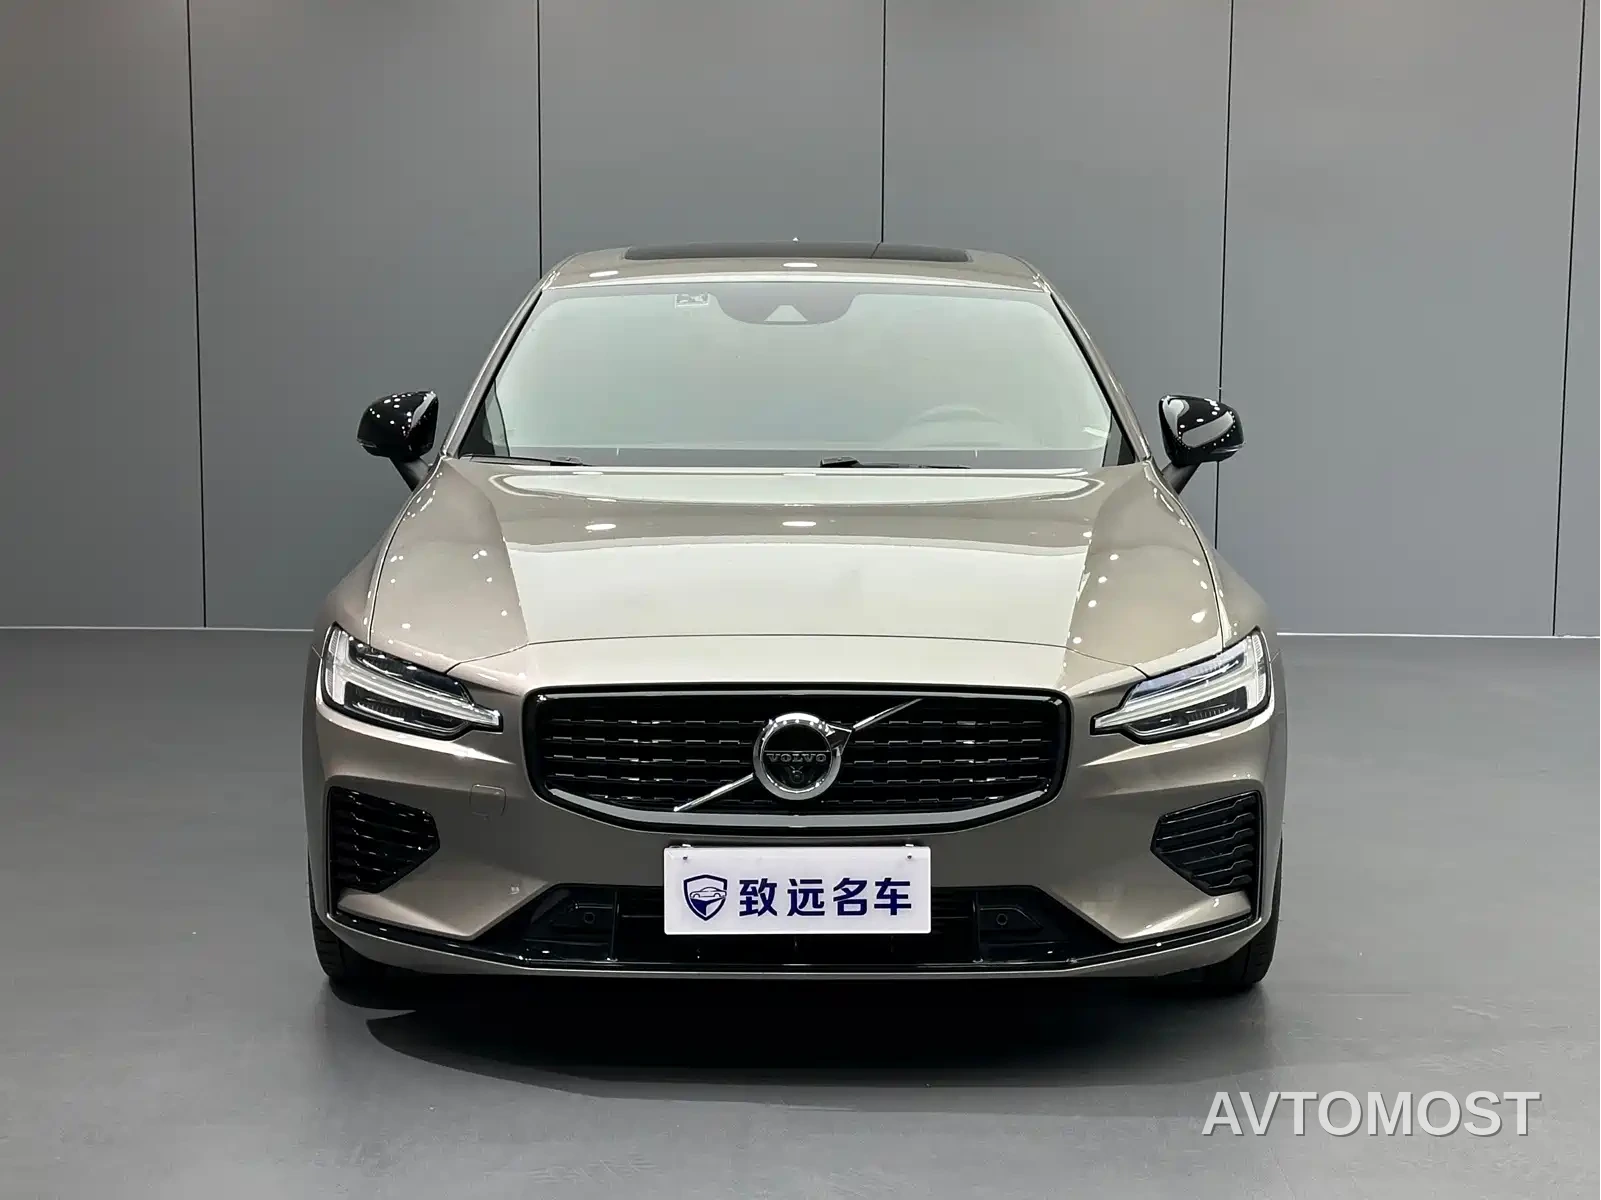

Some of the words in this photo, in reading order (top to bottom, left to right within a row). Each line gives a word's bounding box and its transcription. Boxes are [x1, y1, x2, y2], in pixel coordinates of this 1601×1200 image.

[766, 753, 827, 763] VOLVO
[739, 877, 912, 917] 致远名车
